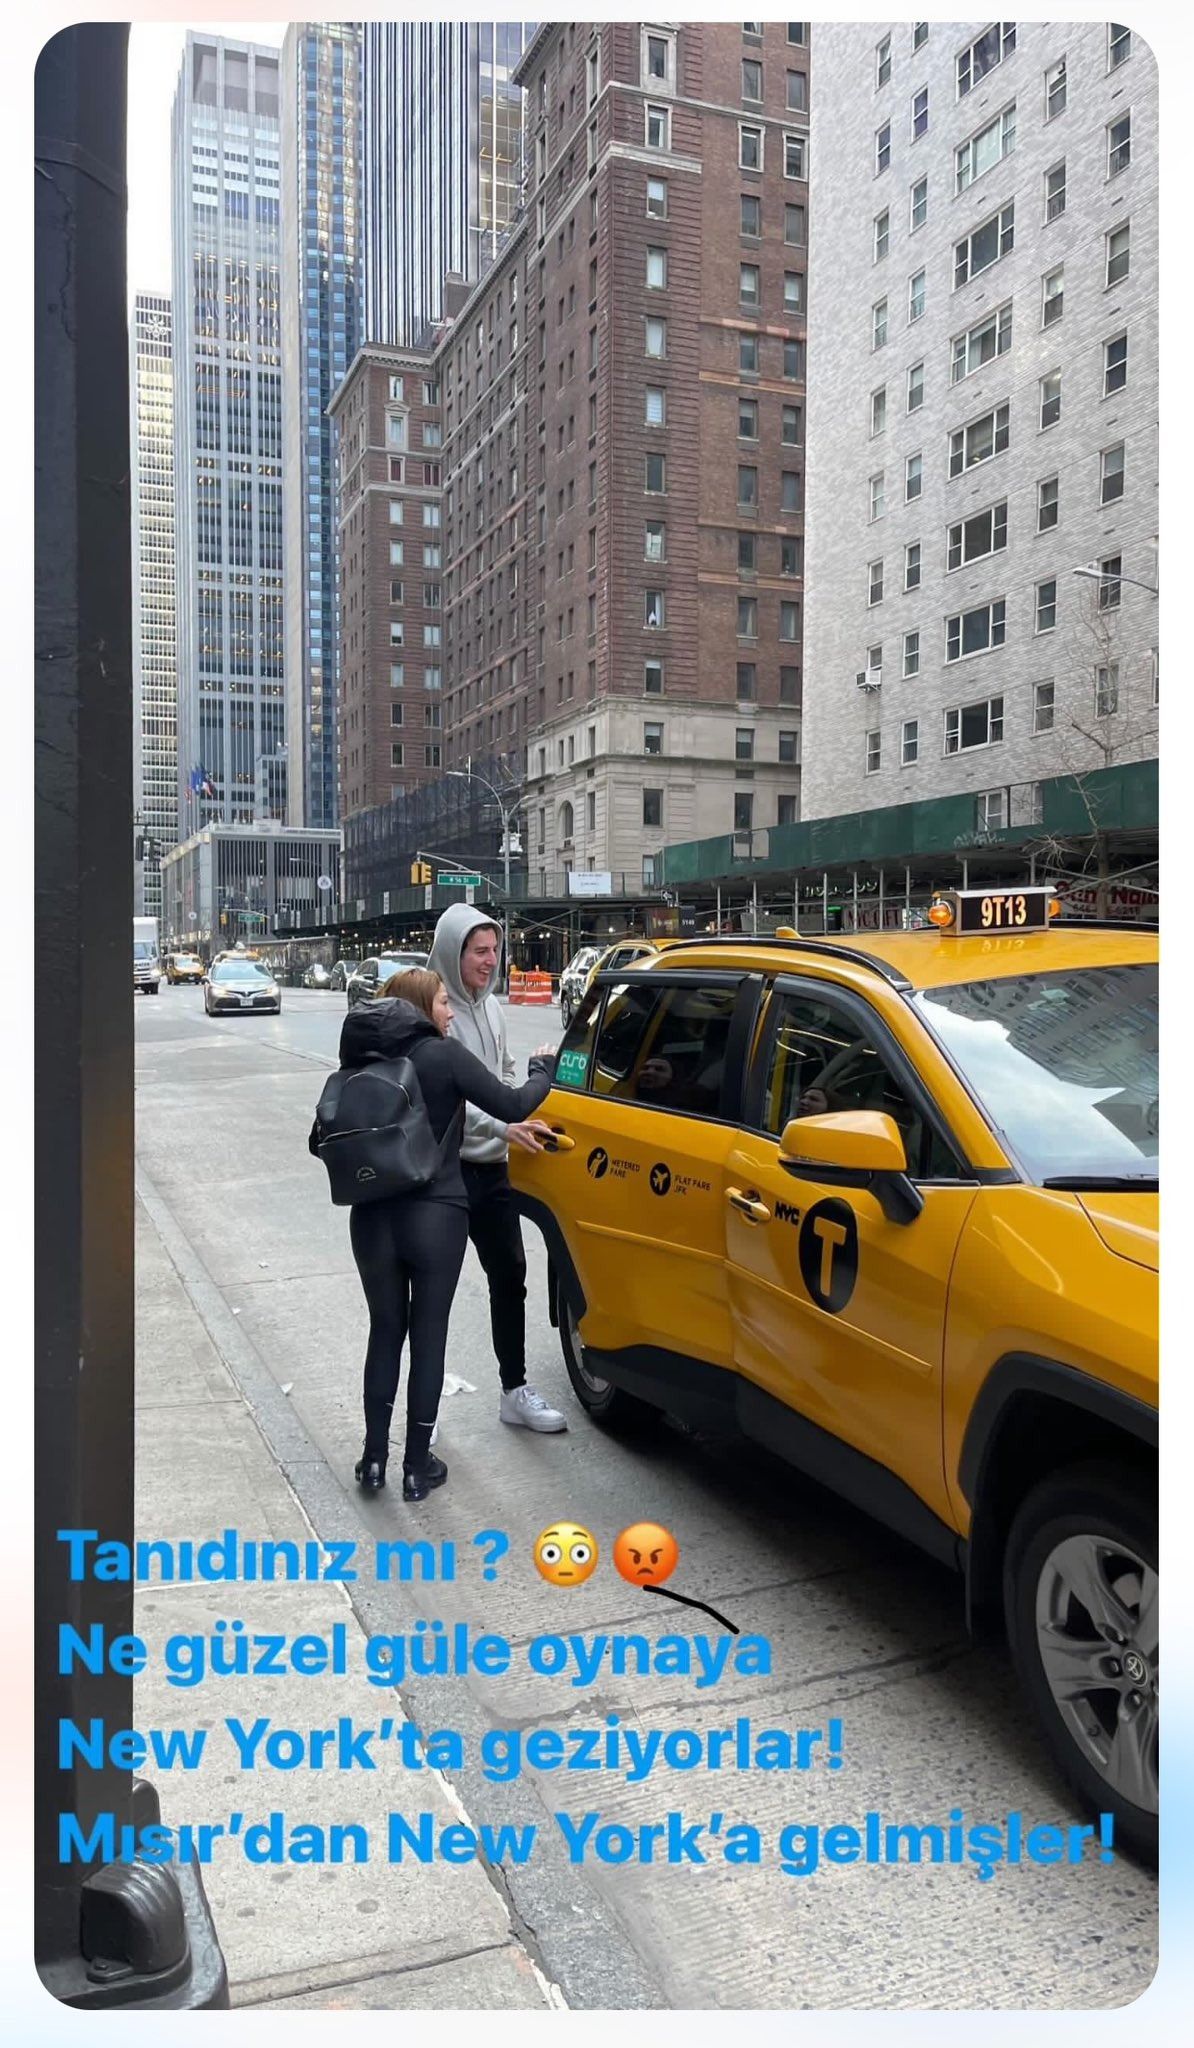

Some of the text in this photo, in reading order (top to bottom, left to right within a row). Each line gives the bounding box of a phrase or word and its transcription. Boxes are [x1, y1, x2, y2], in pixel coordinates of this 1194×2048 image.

[981, 895, 1027, 927] 9T13
[560, 1053, 587, 1070] curb
[609, 1167, 627, 1178] FARE
[611, 1159, 641, 1173] METERED
[673, 1184, 687, 1195] JFK
[674, 1174, 711, 1191] FLAT FARE
[774, 1200, 800, 1227] NYC
[813, 1215, 847, 1297] T
